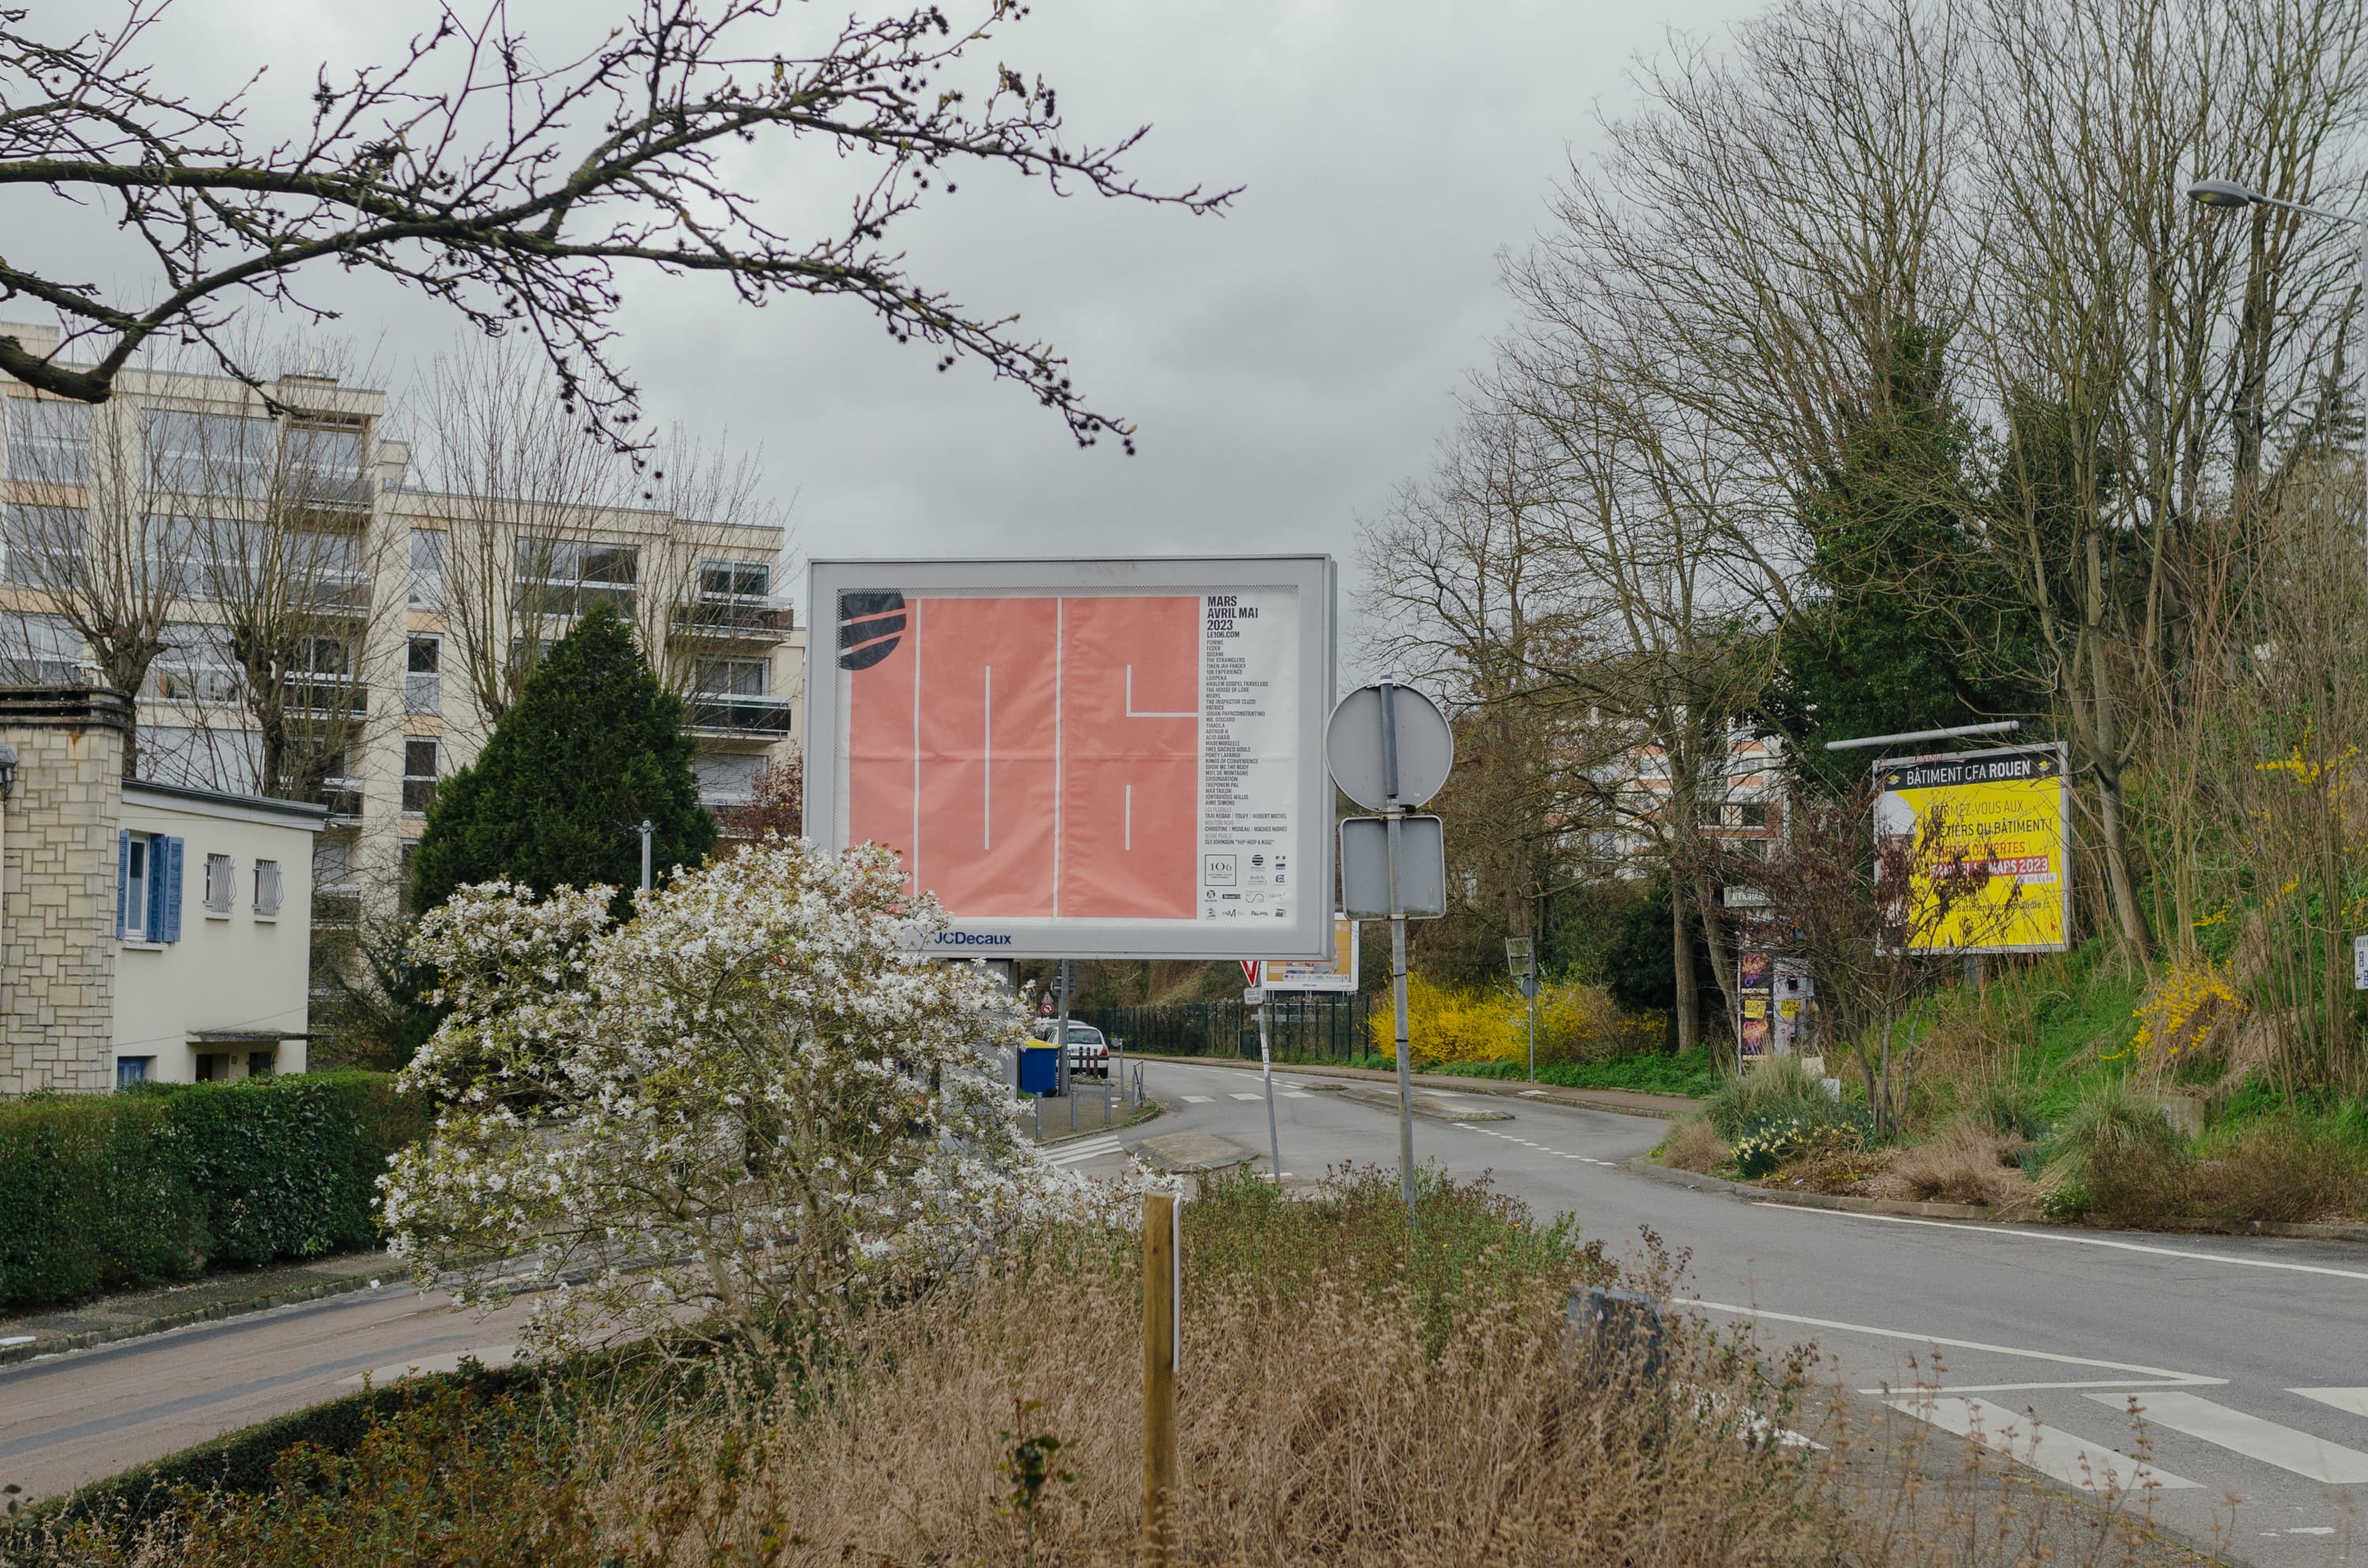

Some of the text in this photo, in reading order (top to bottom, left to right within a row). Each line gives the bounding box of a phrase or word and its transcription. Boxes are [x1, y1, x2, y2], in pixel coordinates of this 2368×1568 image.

[1208, 596, 1237, 607] MARS
[1208, 608, 1258, 619] AVRIL MAI
[1207, 619, 1233, 631] 2023
[1916, 754, 1942, 762] AVENIR
[1907, 760, 2030, 785] BÂTIMENT CFA ROUEN
[2004, 799, 2023, 813] AUX
[1976, 823, 1991, 835] DU
[1995, 818, 2046, 834] BÂTIMENT
[1211, 862, 1232, 871] 106
[2019, 858, 2048, 873] 2023
[935, 931, 1011, 945] JCDecaux
